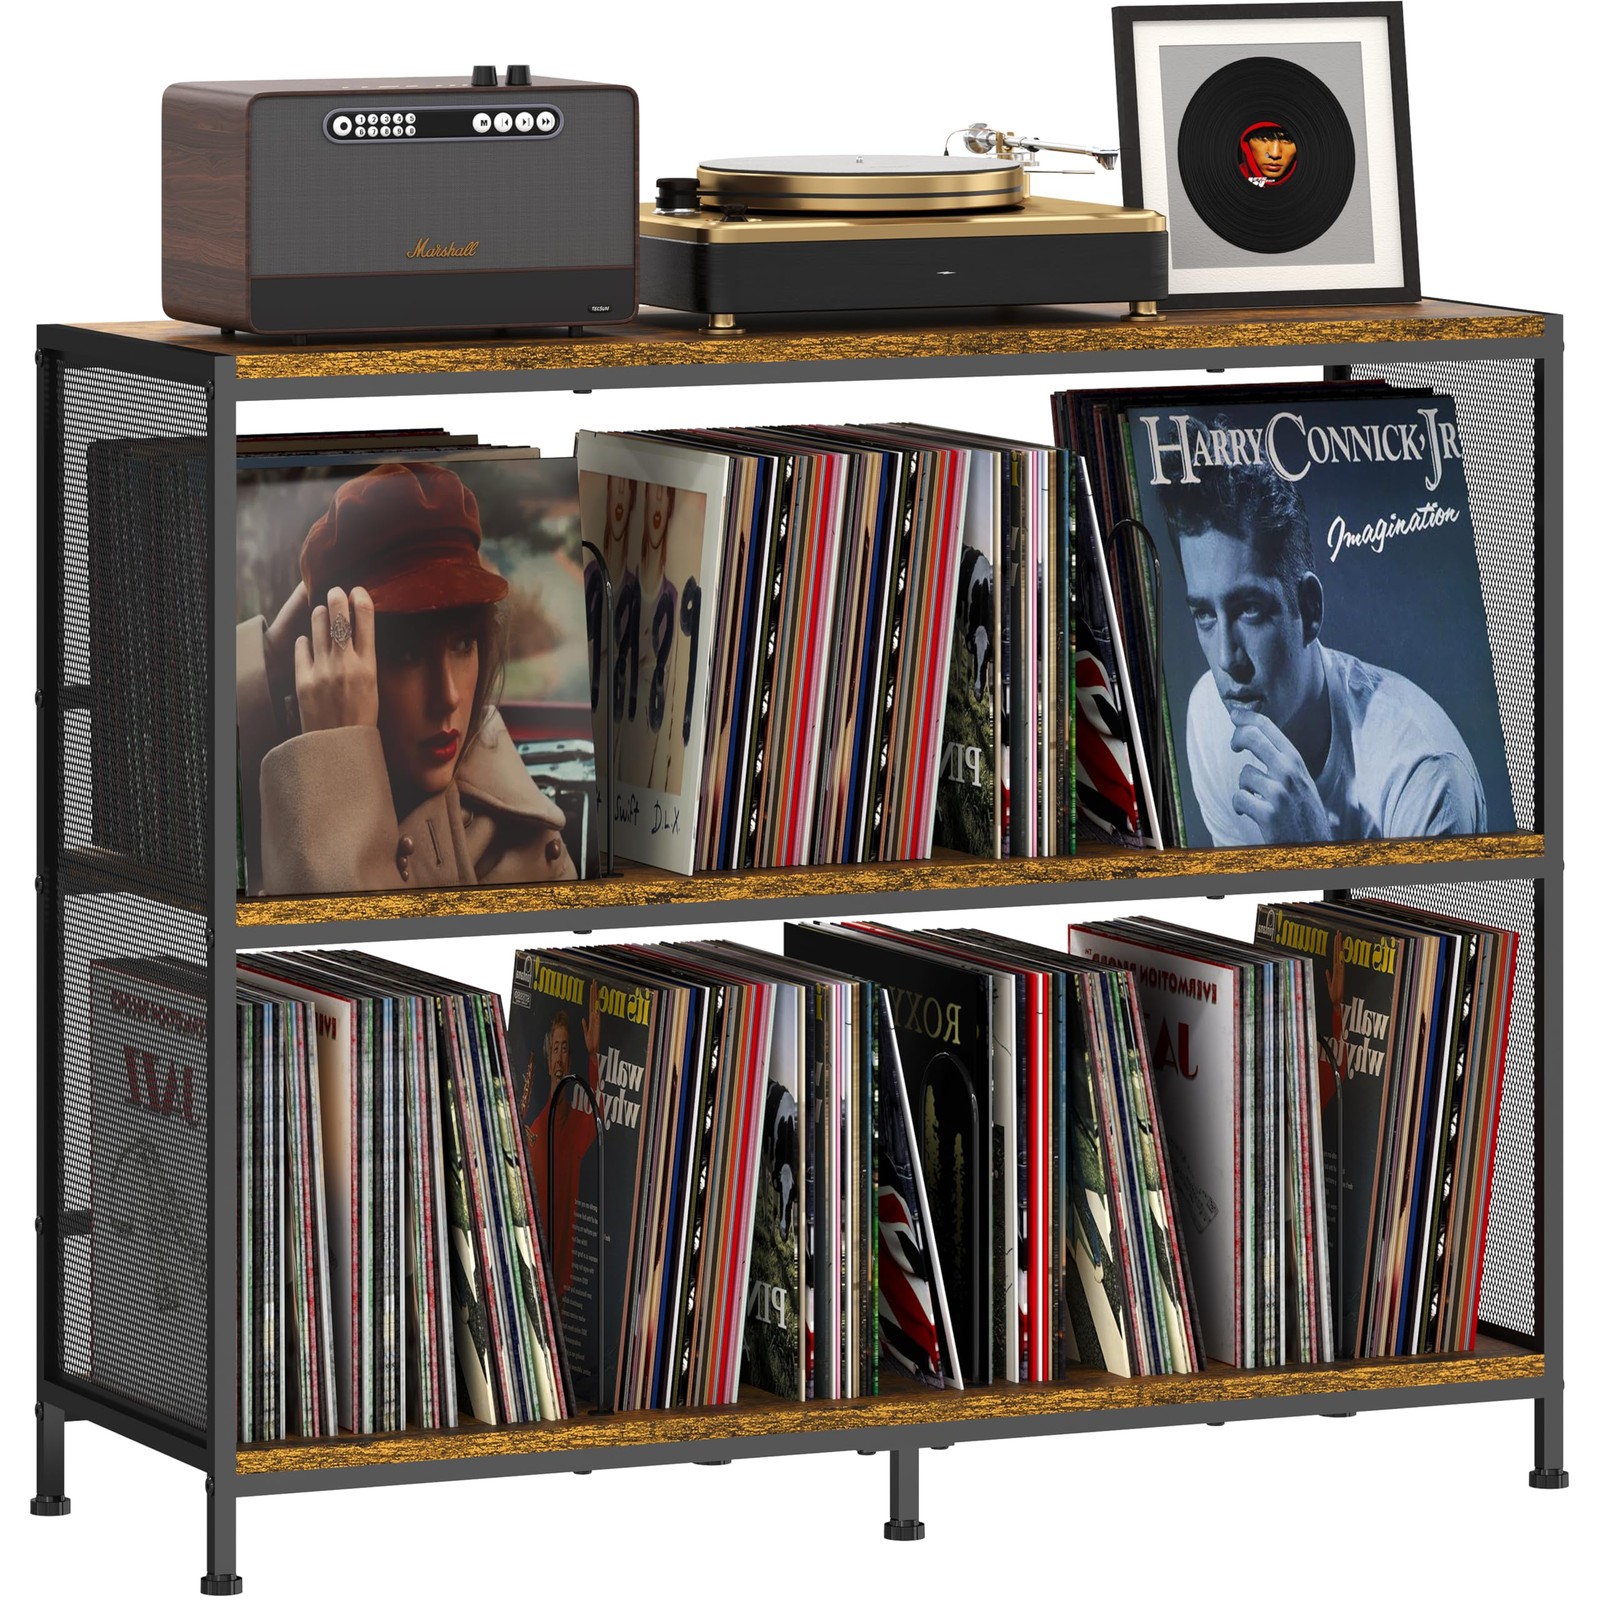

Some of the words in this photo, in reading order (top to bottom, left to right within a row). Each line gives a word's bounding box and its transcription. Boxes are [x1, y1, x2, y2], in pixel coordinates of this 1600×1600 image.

[480, 119, 488, 127] M
[406, 237, 480, 258] Marshall
[1139, 414, 1265, 485] HARRY
[1327, 501, 1461, 563] Imagination
[614, 792, 640, 827] Swift
